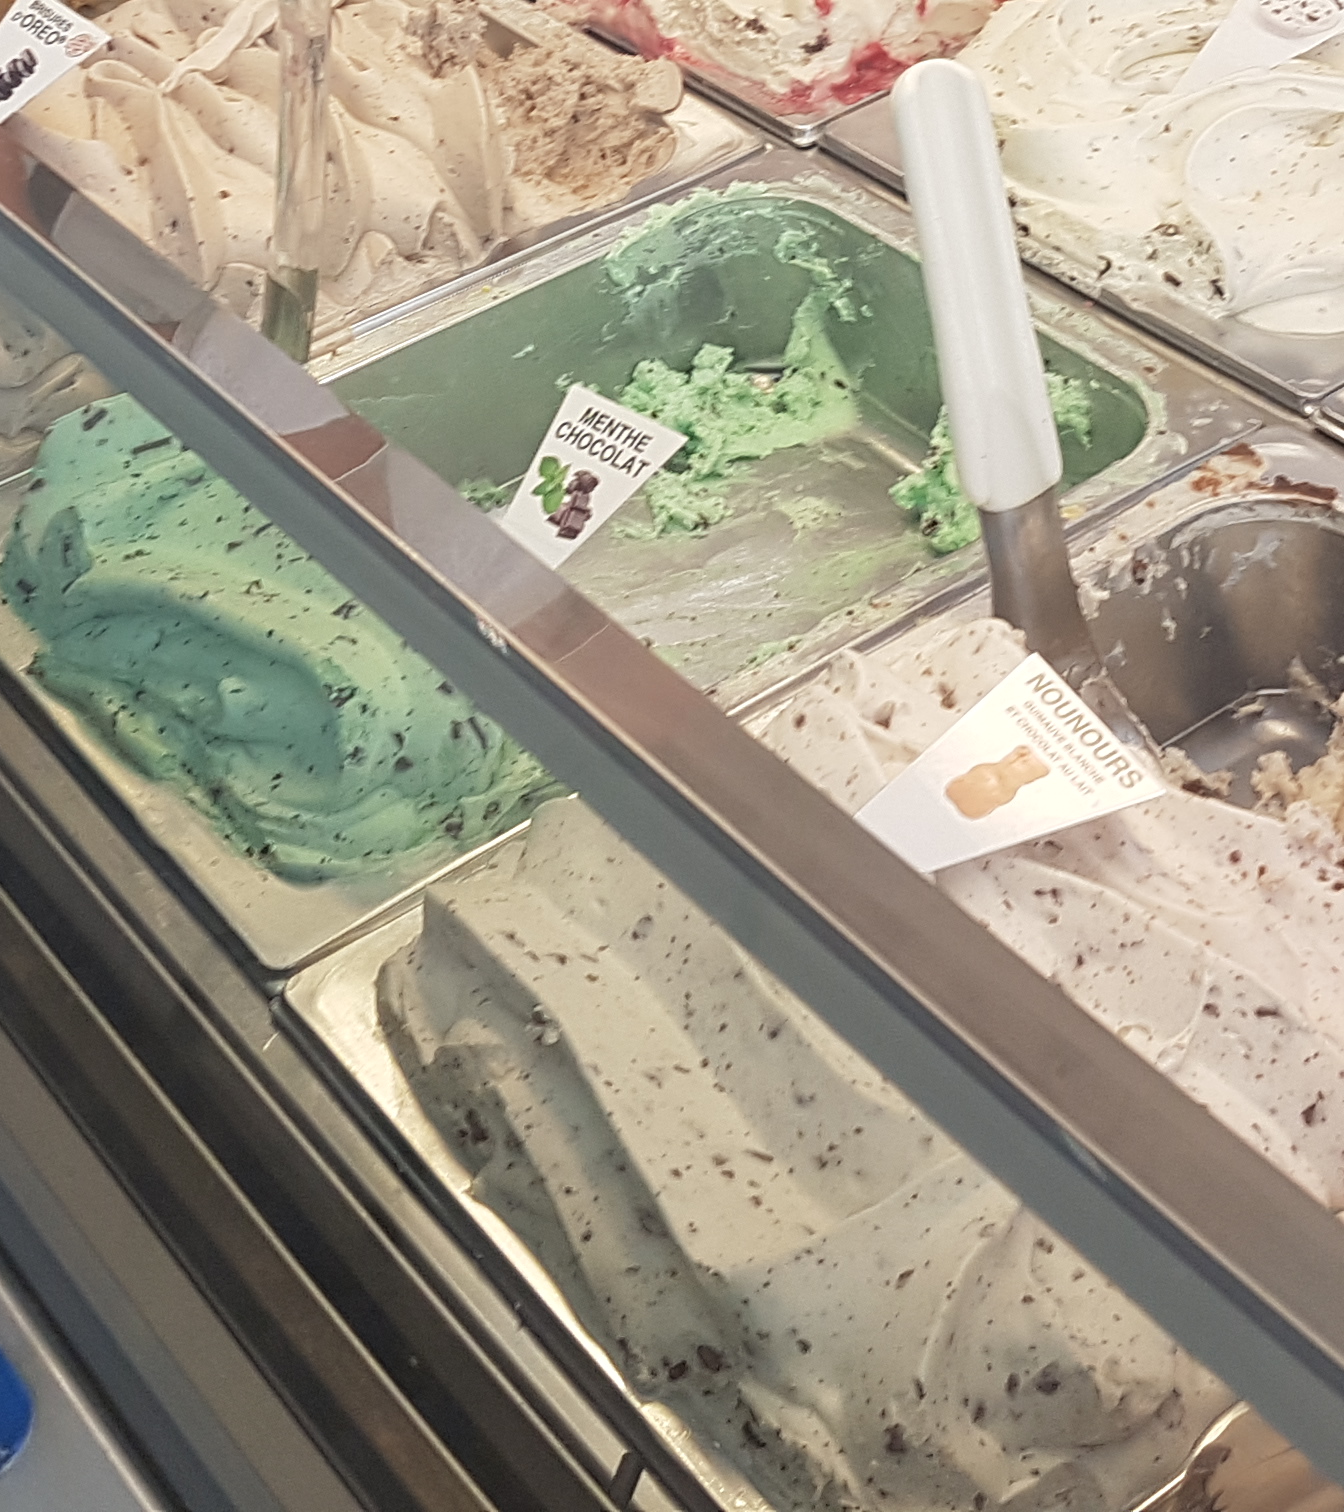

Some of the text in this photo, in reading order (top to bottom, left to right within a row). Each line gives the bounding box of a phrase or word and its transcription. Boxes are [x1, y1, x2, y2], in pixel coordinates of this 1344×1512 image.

[28, 0, 74, 33] BRISURES
[555, 421, 651, 479] CHOCOLAT
[577, 406, 654, 454] MENTHE
[1005, 704, 1096, 796] ET CHOCOLAT AU LAIT
[1025, 671, 1144, 789] NOUNOURS
[1063, 742, 1107, 785] BLANCHE
